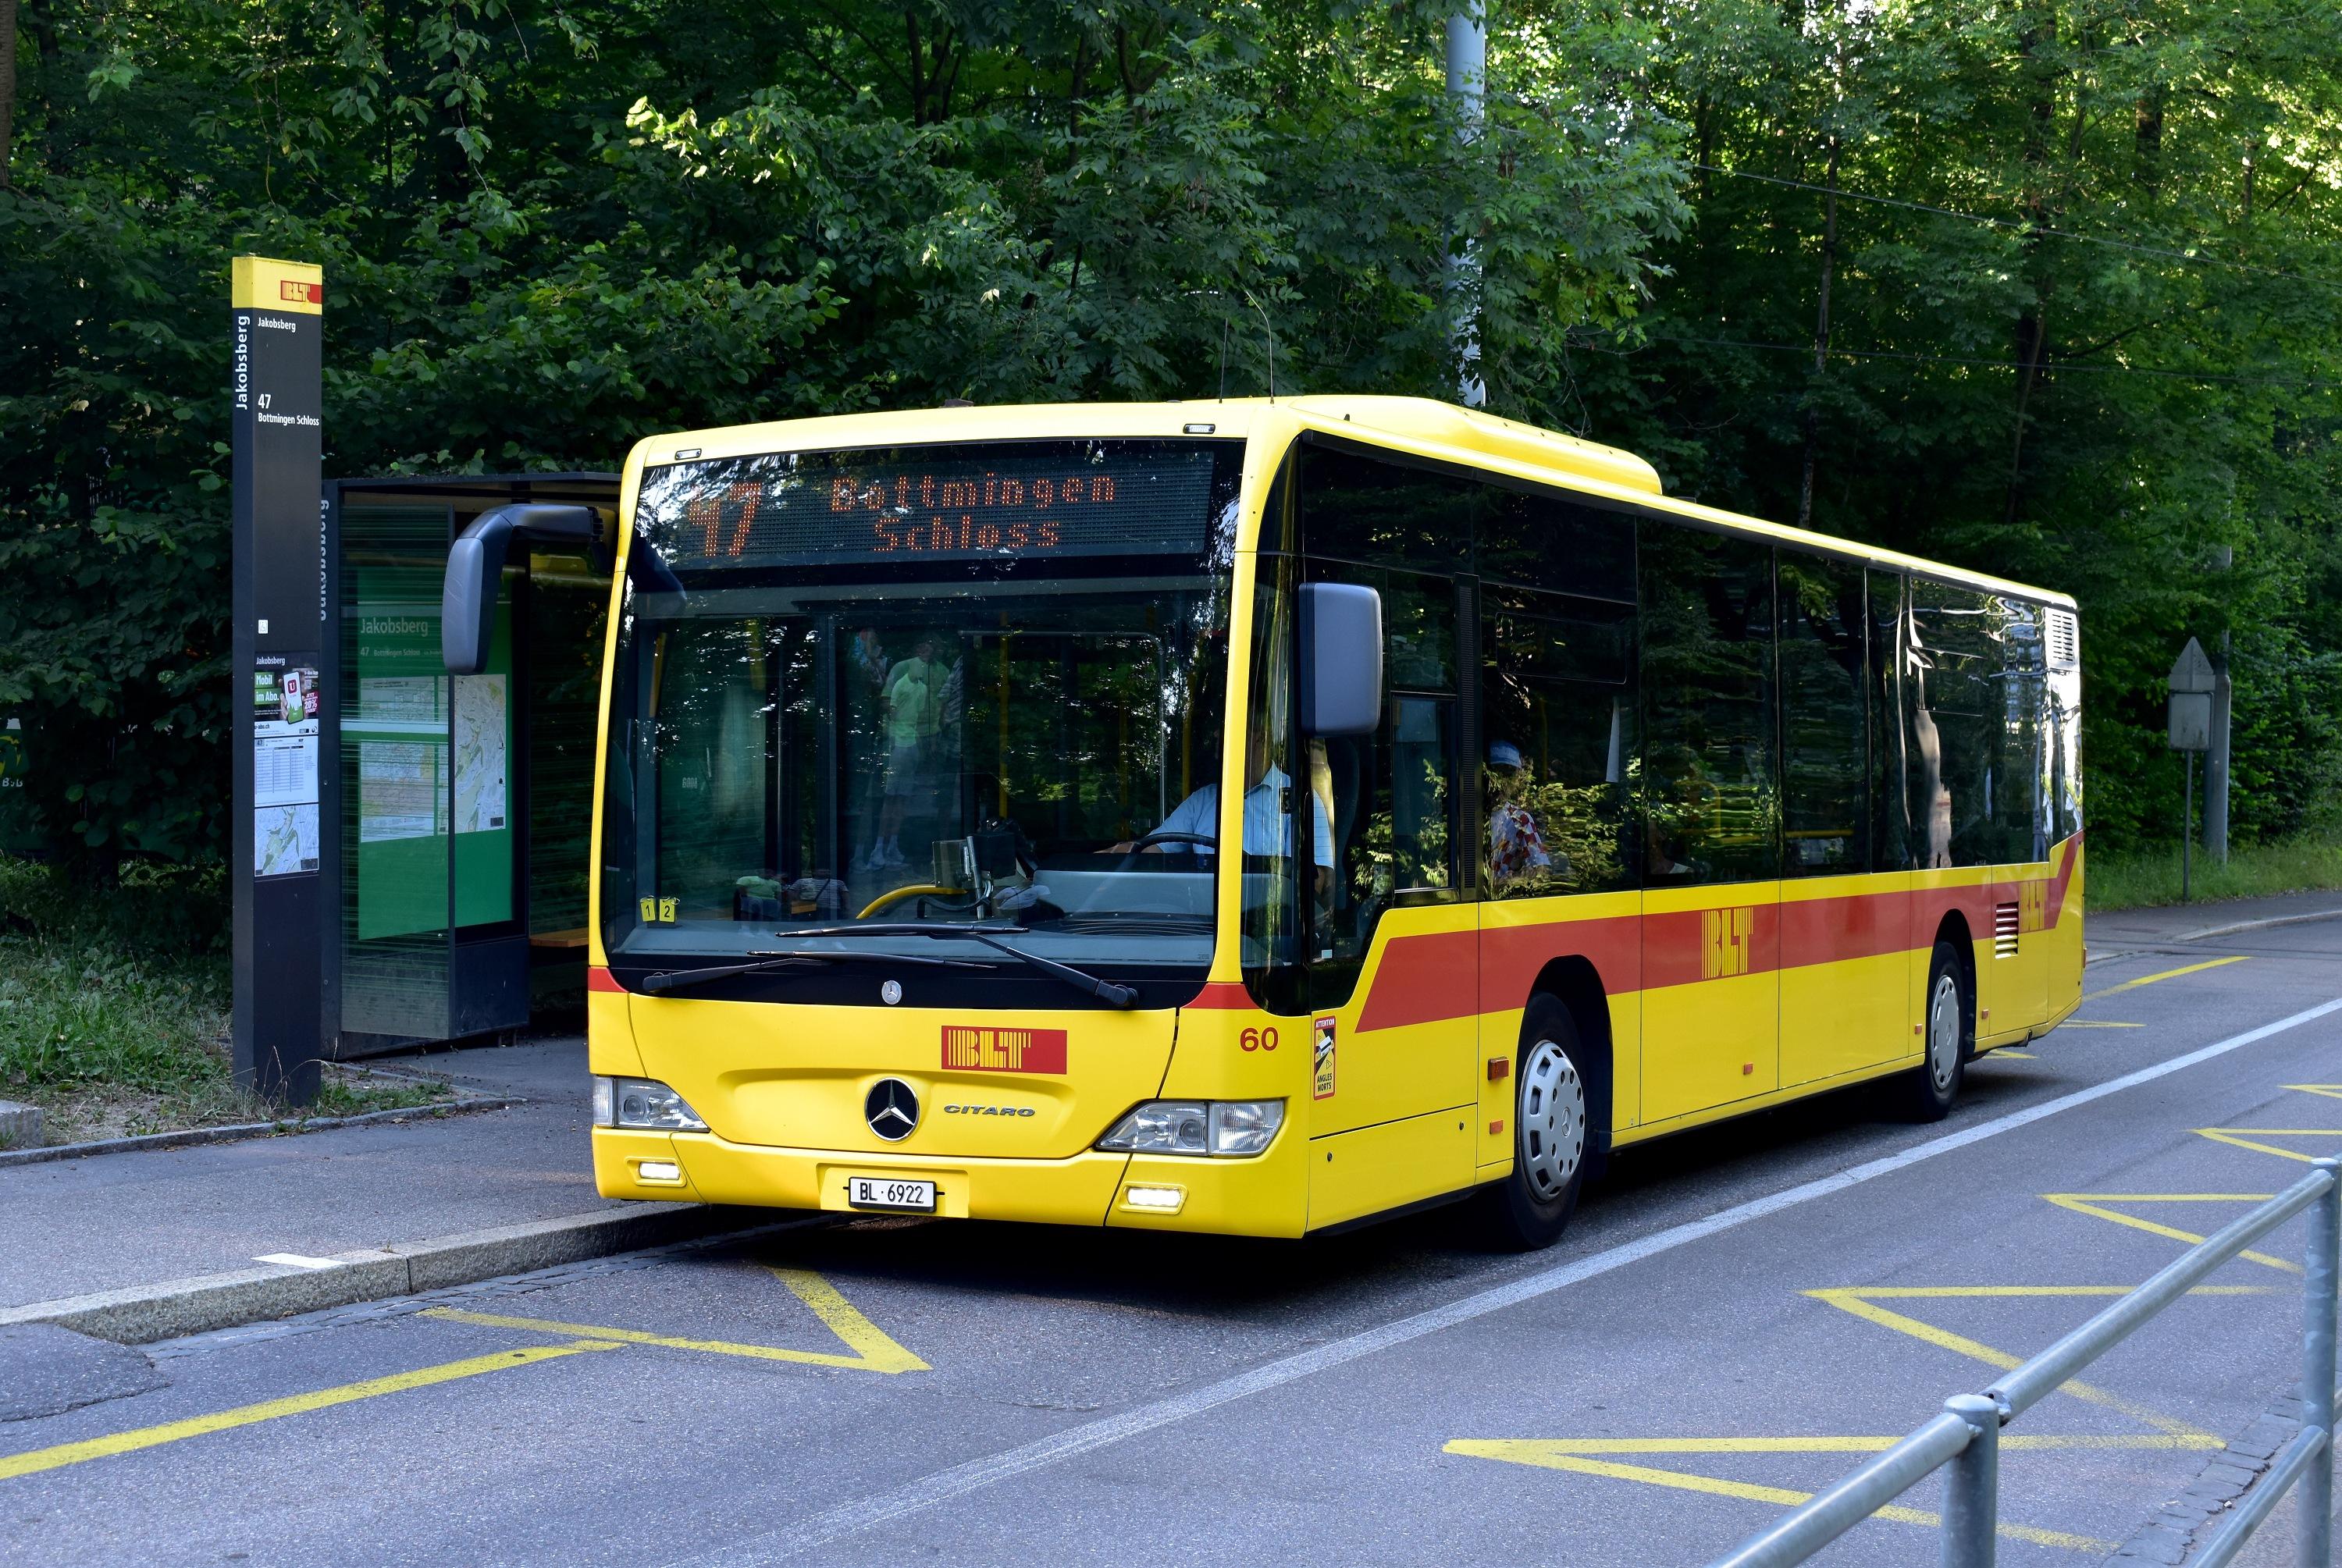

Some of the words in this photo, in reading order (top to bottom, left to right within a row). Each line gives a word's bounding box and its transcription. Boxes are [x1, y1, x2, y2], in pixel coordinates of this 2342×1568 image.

[282, 283, 310, 301] BLT
[258, 317, 296, 333] Jakobsberg
[235, 315, 251, 411] Jakobsberg
[258, 393, 272, 409] 47
[258, 412, 295, 426] Bottmingen
[297, 414, 319, 426] Schloss
[831, 473, 1116, 511] Bottmingen
[689, 481, 763, 556] 47
[874, 515, 1059, 552] Schloss
[360, 617, 428, 637] Jakobsberg
[360, 646, 369, 656] 47
[373, 649, 401, 659] Bottmingen
[256, 656, 286, 666] Jakobsberg
[256, 674, 272, 685] Mobil
[256, 692, 265, 702] im
[265, 691, 279, 701] Abo.
[304, 699, 318, 709] 20%
[646, 905, 650, 918] 1
[664, 905, 671, 918] 2
[1701, 907, 1753, 980] BLT
[1316, 1019, 1334, 1028] ATTENTION
[1240, 1026, 1279, 1052] 60
[948, 1029, 1032, 1069] BLT
[1317, 1073, 1332, 1083] ANGLES
[1318, 1082, 1332, 1092] MORTS
[943, 1104, 1036, 1117] CITARO
